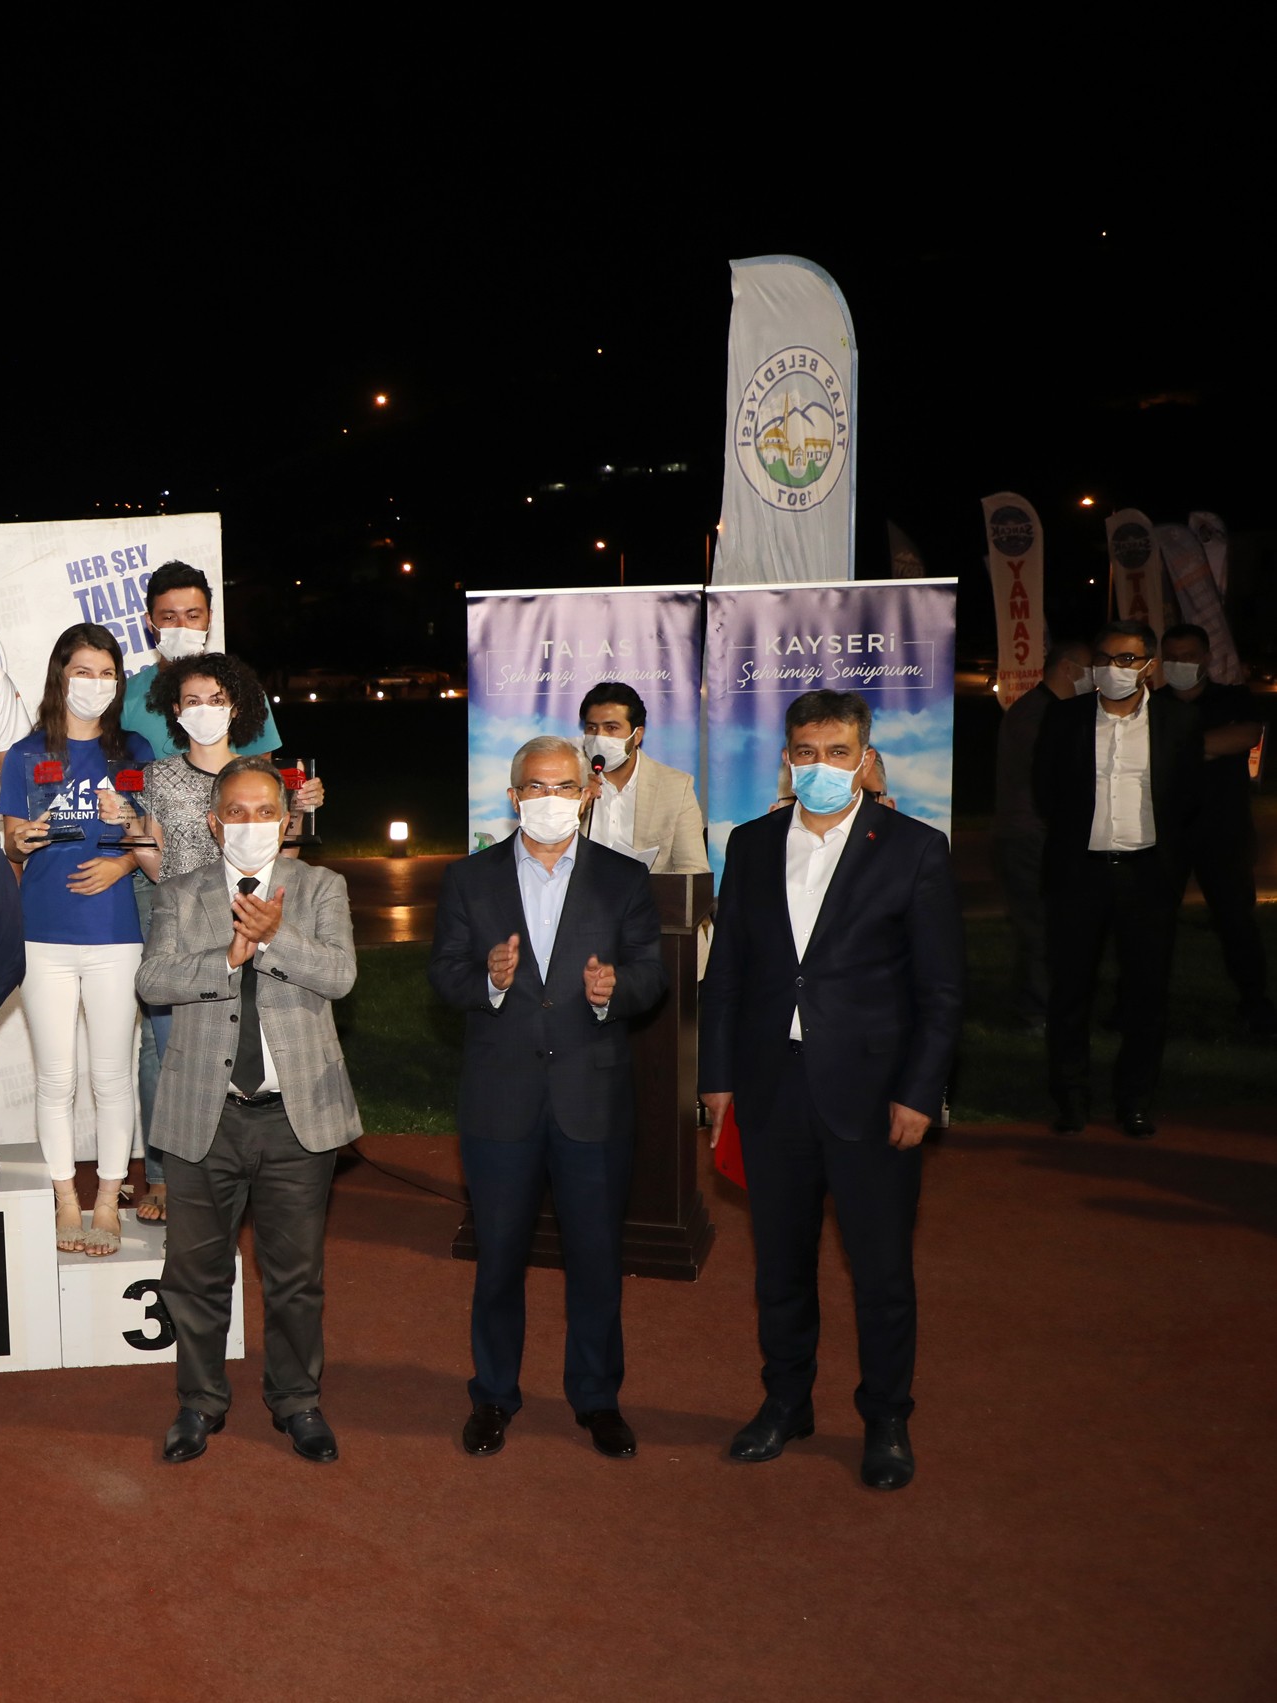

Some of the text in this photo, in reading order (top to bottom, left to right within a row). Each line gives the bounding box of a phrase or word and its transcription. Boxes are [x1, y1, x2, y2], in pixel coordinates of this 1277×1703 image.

[65, 555, 108, 585] HER
[110, 543, 149, 577] ŞEY
[539, 638, 634, 659] TALAS
[496, 664, 577, 691] Şehrimizi
[736, 660, 824, 688] Şehrimizi
[122, 1278, 178, 1351] 3
